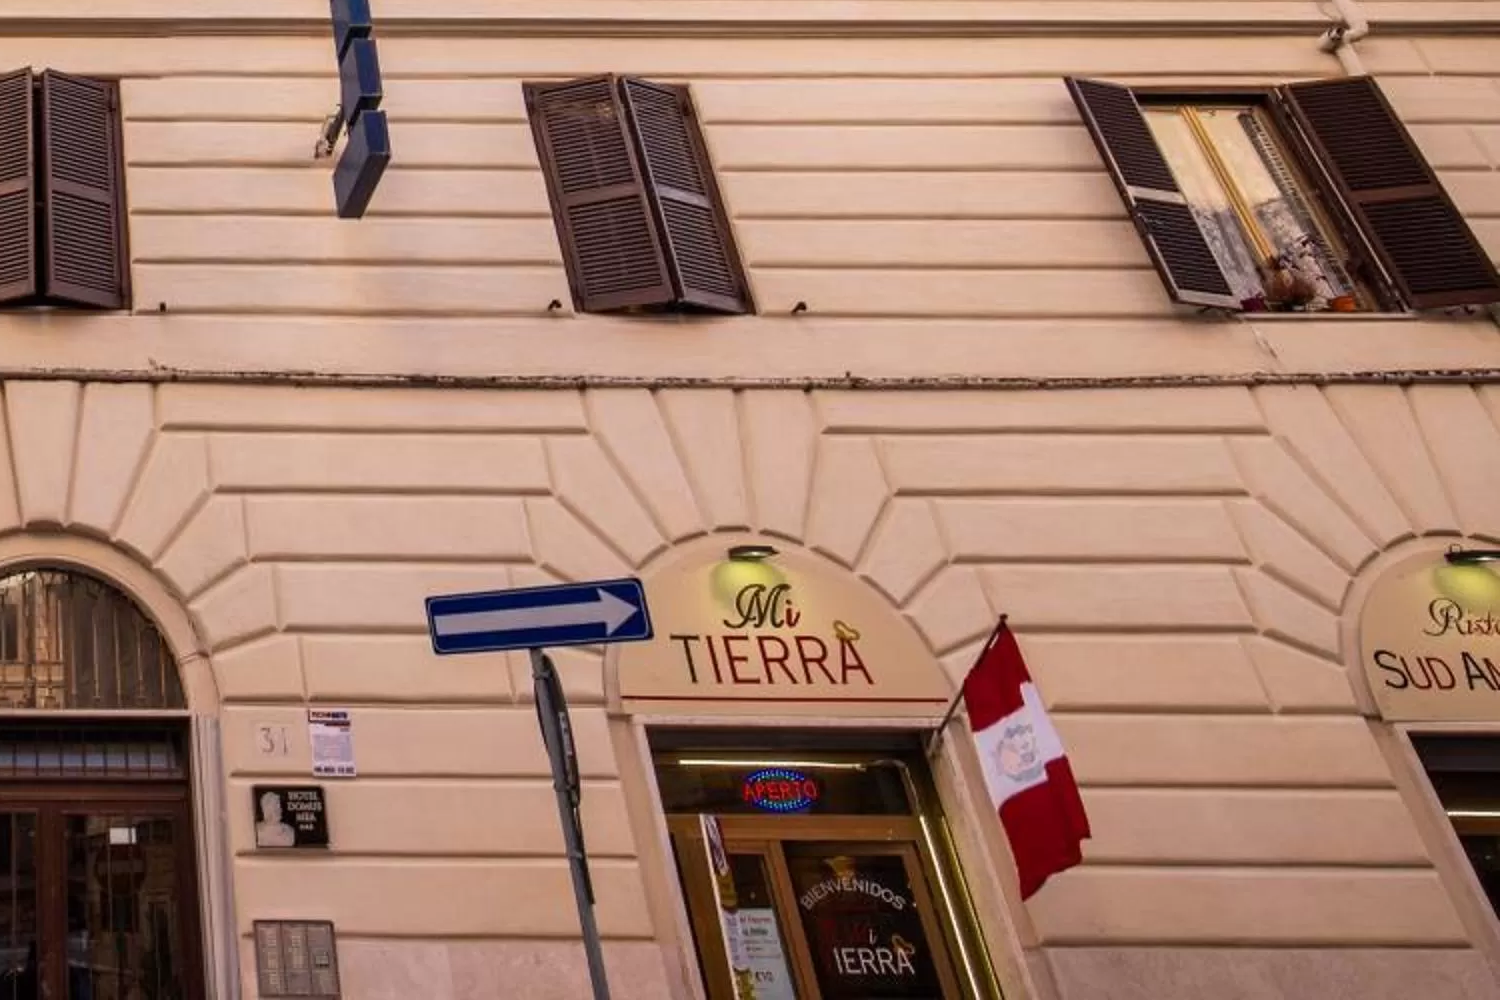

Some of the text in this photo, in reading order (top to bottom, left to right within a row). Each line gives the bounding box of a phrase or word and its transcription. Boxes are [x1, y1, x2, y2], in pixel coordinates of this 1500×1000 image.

[723, 583, 801, 629] Mi
[669, 634, 874, 685] TIERRA
[1373, 649, 1456, 690] SUD
[742, 780, 818, 803] APERTO
[800, 877, 906, 911] BIENVENIDOS
